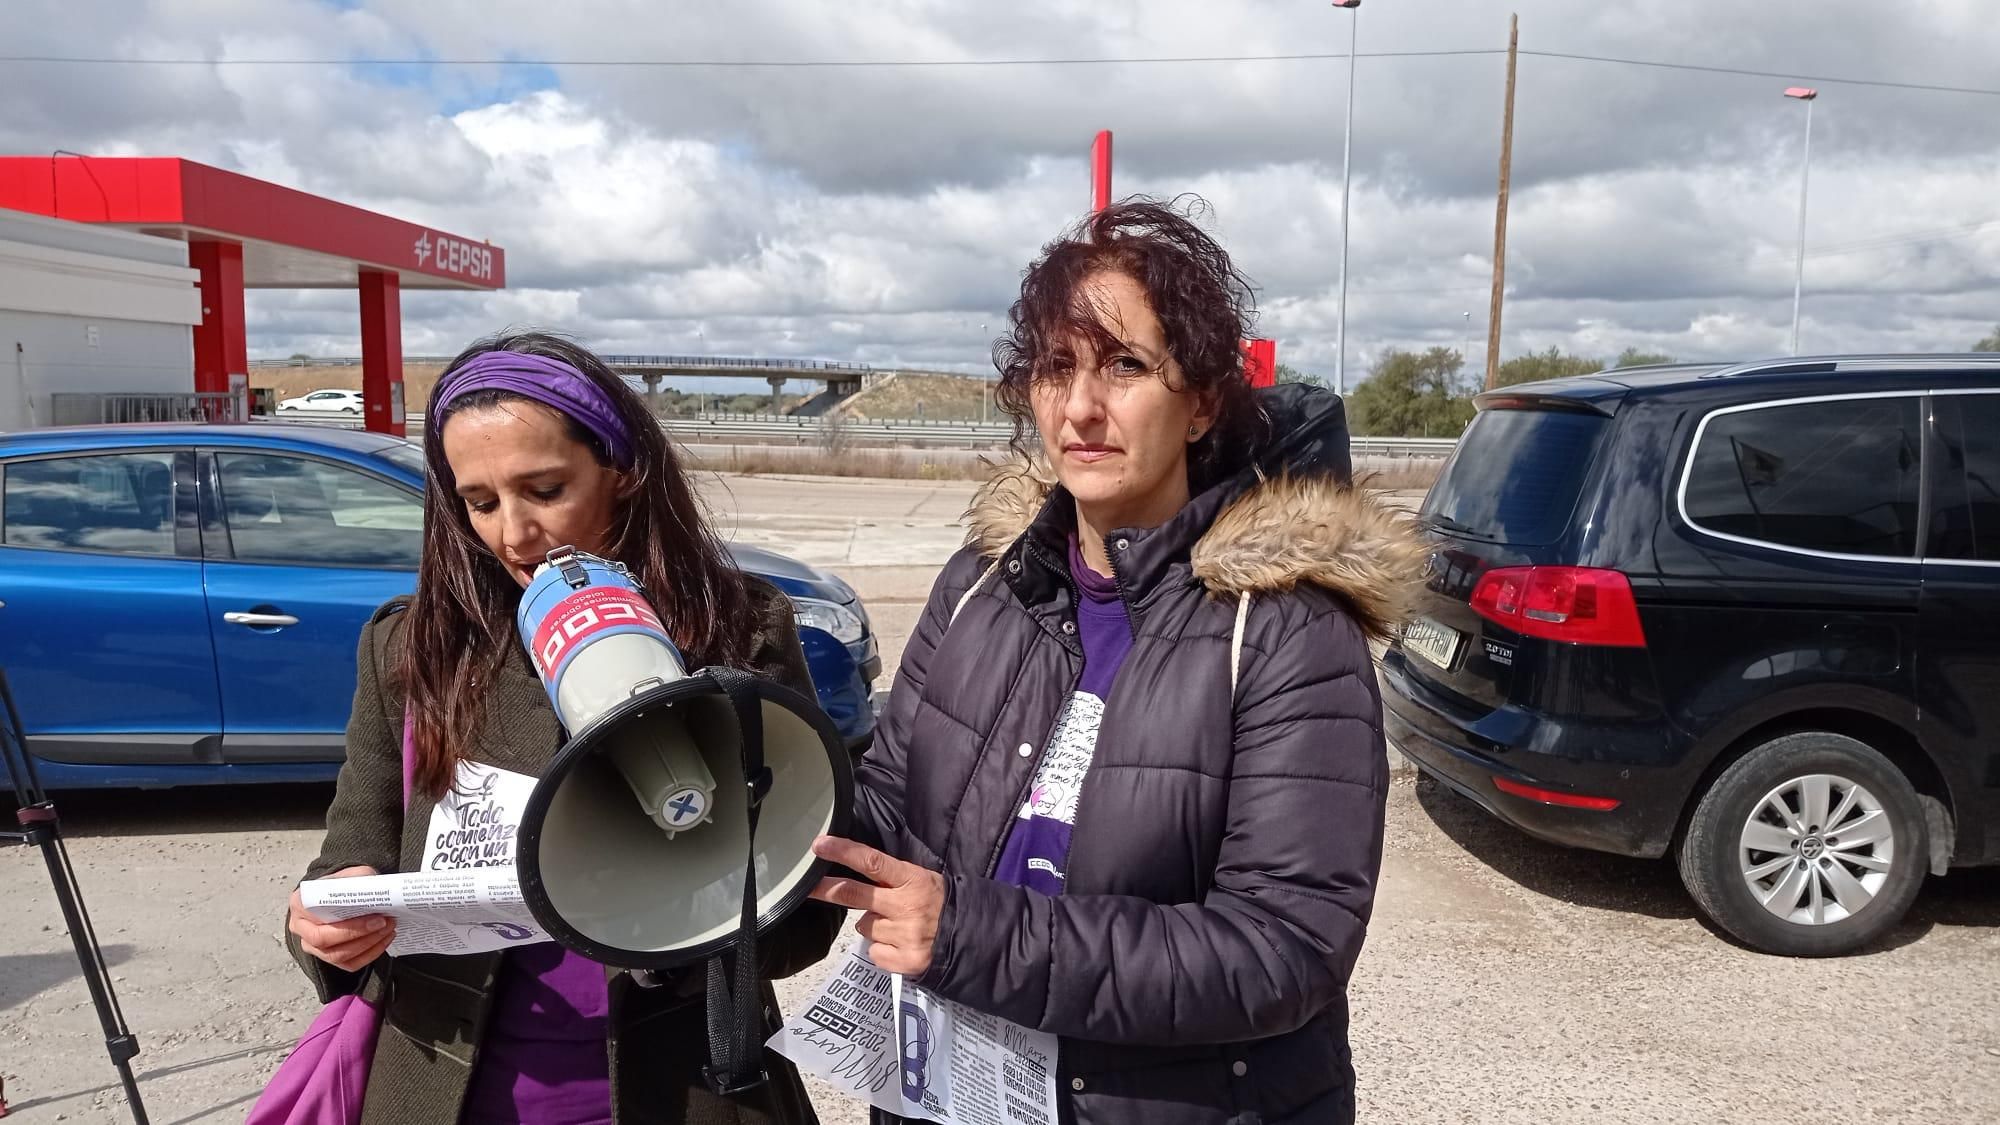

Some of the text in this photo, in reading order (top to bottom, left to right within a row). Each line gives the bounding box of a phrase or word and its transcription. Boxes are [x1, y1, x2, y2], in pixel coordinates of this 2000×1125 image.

[436, 237, 491, 280] CEPSA
[573, 591, 605, 604] toledo
[550, 605, 581, 631] obreras
[456, 800, 504, 829] Todo
[436, 824, 519, 850] comienz
[449, 845, 480, 864] con
[483, 841, 508, 858] un
[817, 995, 846, 1014] HECHOS
[806, 1008, 887, 1052] 2022 CCOO
